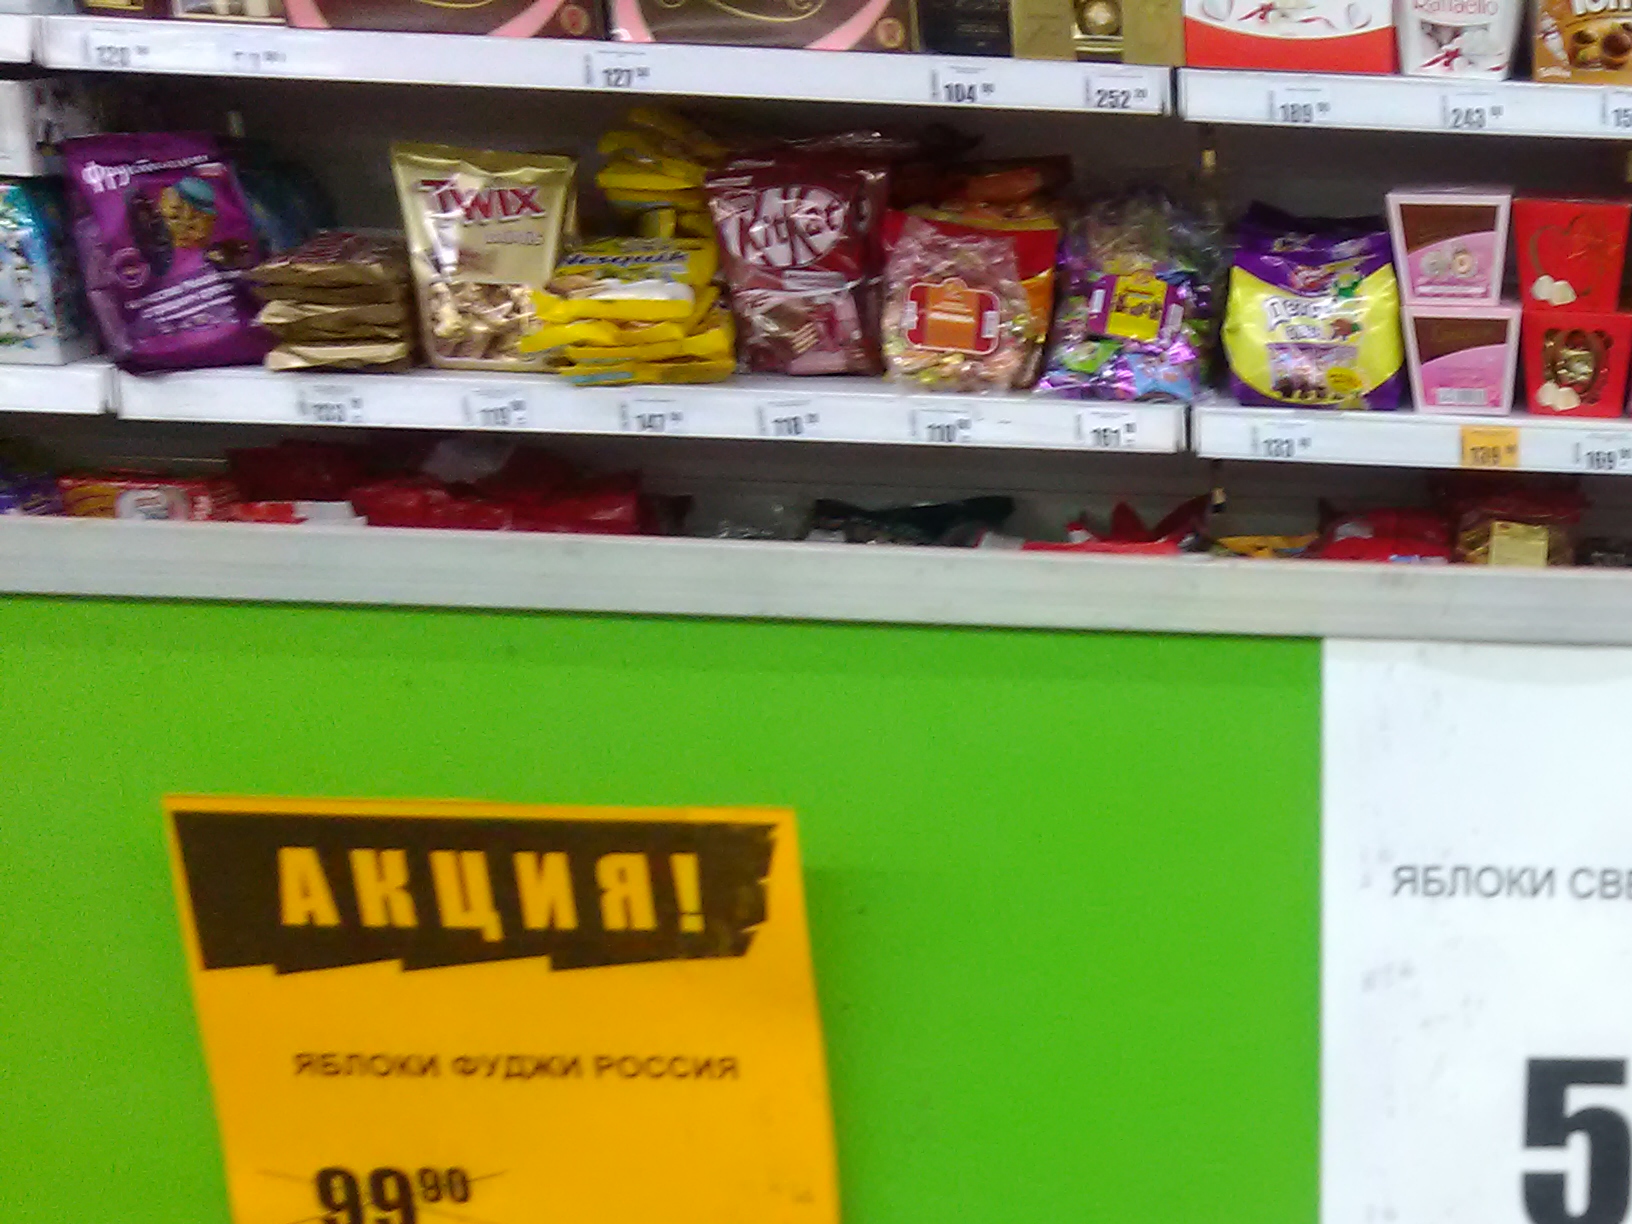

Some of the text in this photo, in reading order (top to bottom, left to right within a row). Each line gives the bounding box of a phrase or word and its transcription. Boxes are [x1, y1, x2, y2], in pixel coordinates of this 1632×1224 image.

[943, 82, 977, 103] 104
[1096, 88, 1131, 109] 252
[1451, 107, 1487, 129] 243
[277, 844, 704, 942] АКЦИЯ!
[1392, 865, 1556, 898] ЯБЛОКИ
[293, 1052, 740, 1082] ЯБЛОКИ ФУДЖИ РОССИЯ
[417, 1167, 473, 1204] 90
